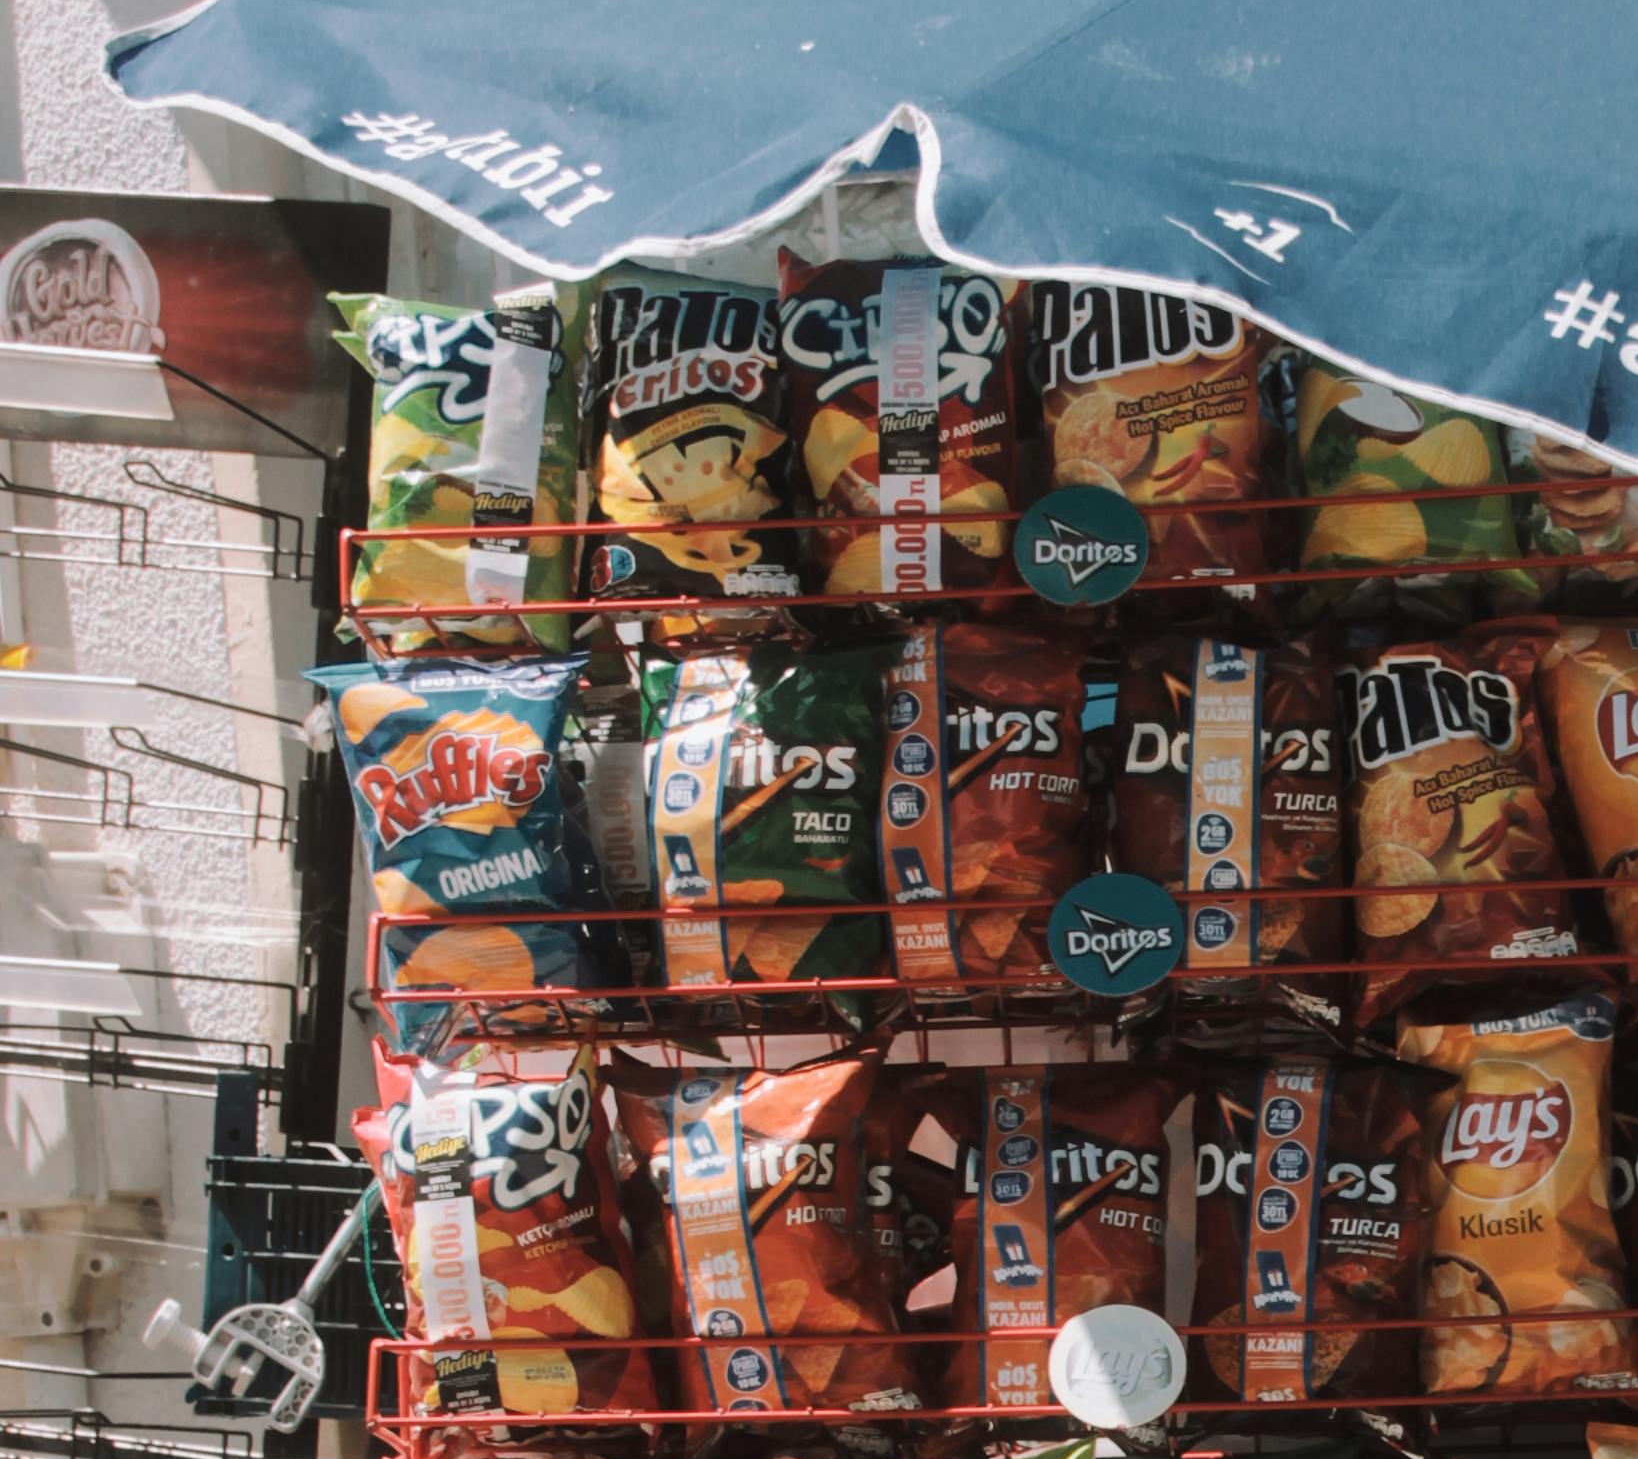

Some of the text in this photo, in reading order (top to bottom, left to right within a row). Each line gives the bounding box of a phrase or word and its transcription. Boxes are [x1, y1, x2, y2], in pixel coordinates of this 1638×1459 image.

[1130, 420, 1154, 437] Hot
[1159, 411, 1193, 430] Spice
[1035, 538, 1137, 566] Doritos
[945, 706, 1063, 753] ritos
[727, 738, 856, 792] ritos
[357, 733, 553, 849] Ruffles
[990, 772, 1033, 791] HOT
[1274, 793, 1337, 812] TURCA
[793, 812, 851, 832] TACO
[897, 934, 948, 951] KAZAN!
[1068, 927, 1172, 957] Doritos
[1441, 1086, 1563, 1169] Lay's
[1101, 1207, 1137, 1230] HOT
[1330, 1217, 1400, 1241] TURCA
[1459, 1210, 1544, 1242] Klasik
[989, 1311, 1046, 1328] KAZAN!
